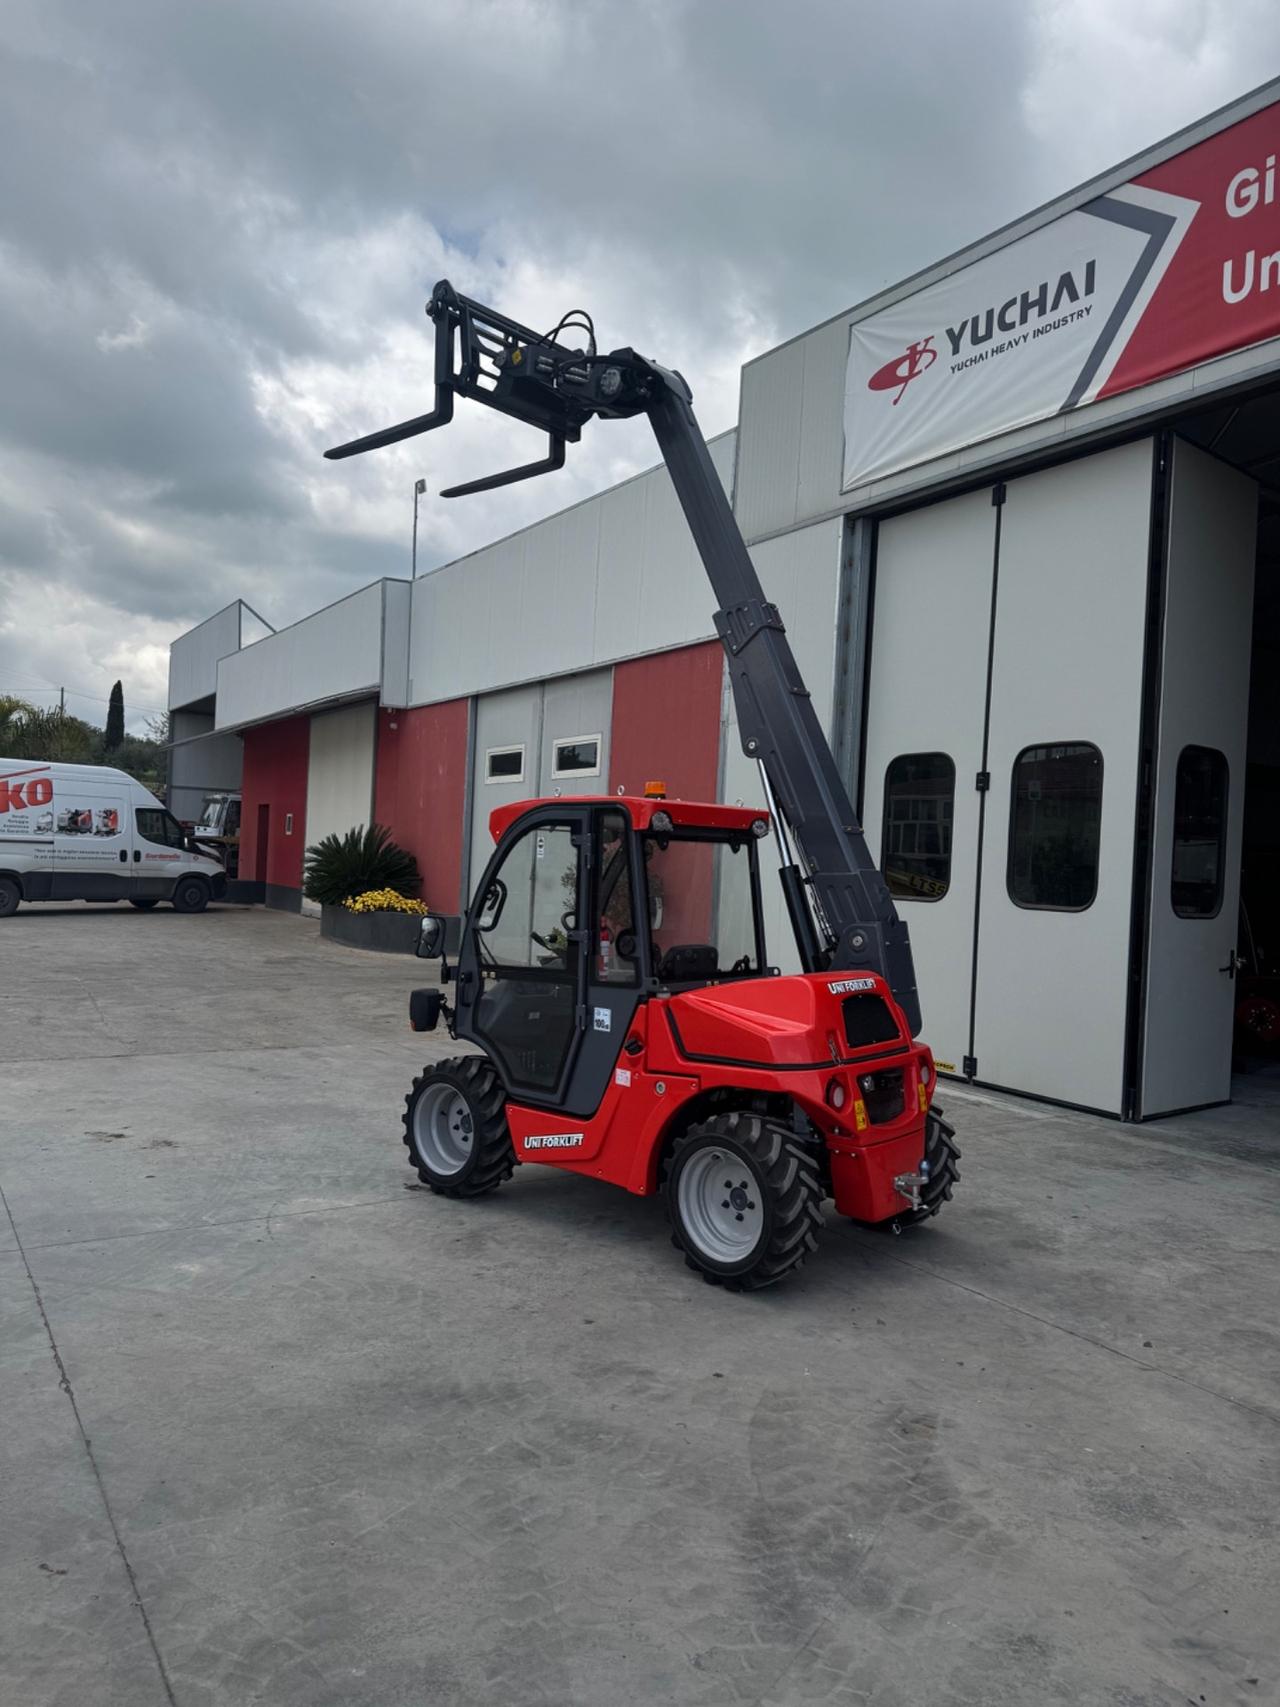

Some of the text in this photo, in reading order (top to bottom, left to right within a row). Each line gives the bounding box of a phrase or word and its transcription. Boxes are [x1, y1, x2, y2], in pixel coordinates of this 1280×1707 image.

[1225, 154, 1276, 218] Gi
[945, 259, 1096, 356] YUCHAI
[950, 304, 1093, 374] YUCHAI HEAVY INDUSTRY
